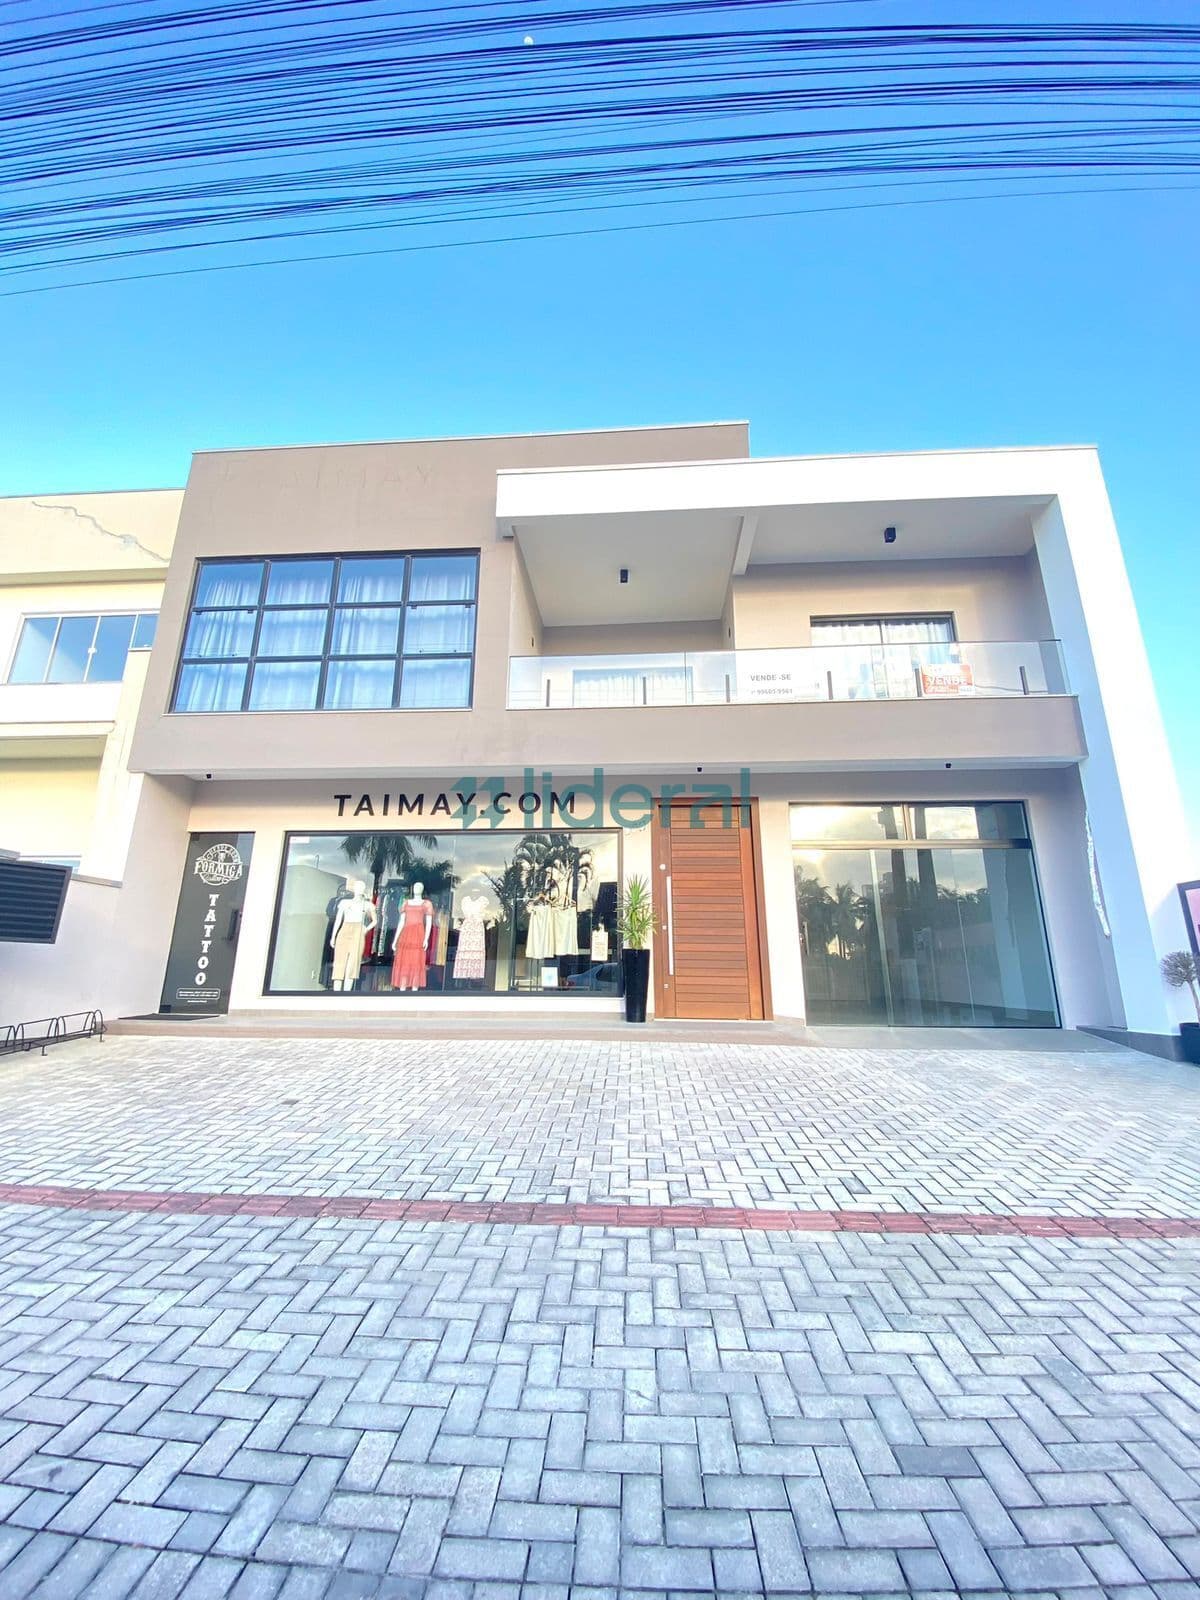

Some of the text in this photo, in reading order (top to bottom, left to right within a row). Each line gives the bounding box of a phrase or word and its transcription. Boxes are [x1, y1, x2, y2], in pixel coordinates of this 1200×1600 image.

[333, 791, 576, 817] TAIMAY.COM
[194, 860, 243, 879] FORMIGA
[195, 893, 220, 986] TATTOO
